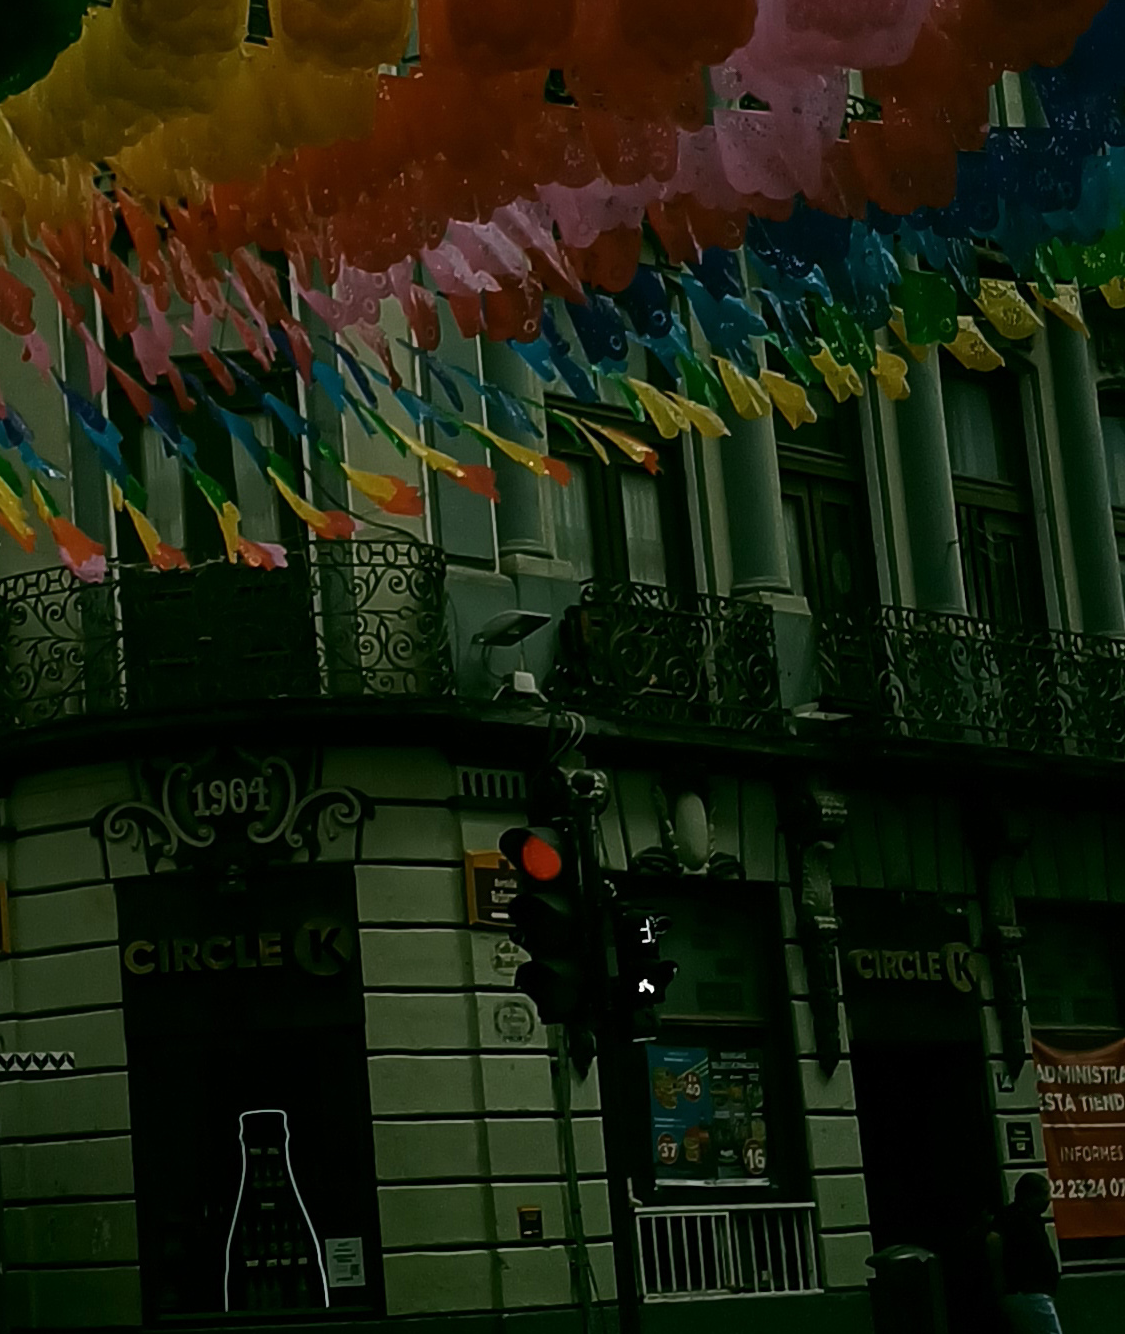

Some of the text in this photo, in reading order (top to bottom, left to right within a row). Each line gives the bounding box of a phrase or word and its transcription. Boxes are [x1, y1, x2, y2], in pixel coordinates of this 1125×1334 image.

[191, 776, 271, 817] 1904
[124, 923, 352, 975] CIRCLE K
[849, 949, 943, 980] CIRCLE
[657, 1142, 678, 1158] 37
[746, 1148, 766, 1169] 16
[1060, 1145, 1124, 1162] INFORMES
[1067, 1178, 1106, 1199] 2324
